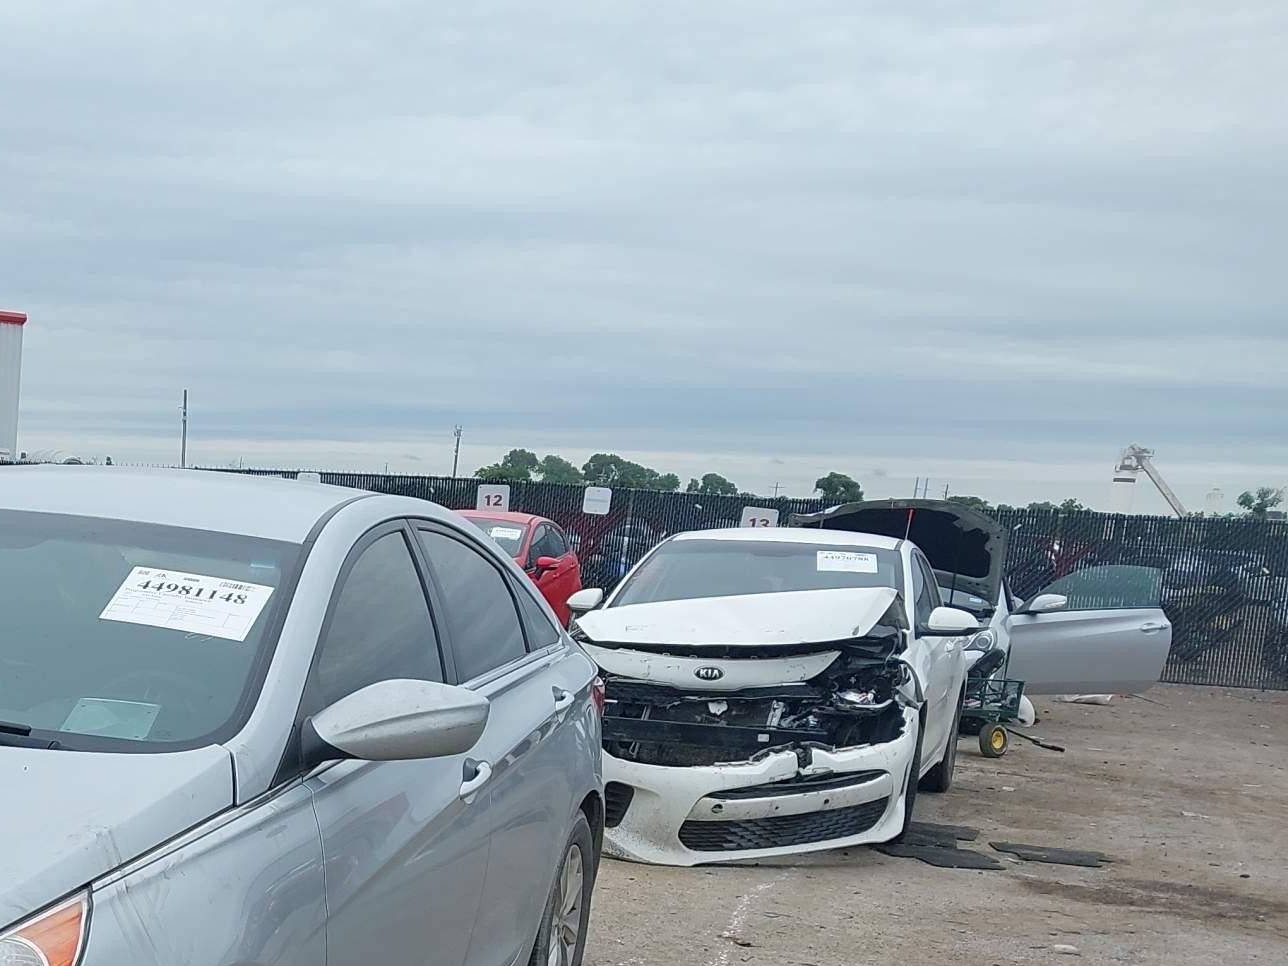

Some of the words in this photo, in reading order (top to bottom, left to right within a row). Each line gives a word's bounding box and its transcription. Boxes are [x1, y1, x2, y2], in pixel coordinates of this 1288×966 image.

[484, 494, 503, 506] 12
[137, 579, 248, 605] 44981148
[699, 668, 720, 678] KIA
